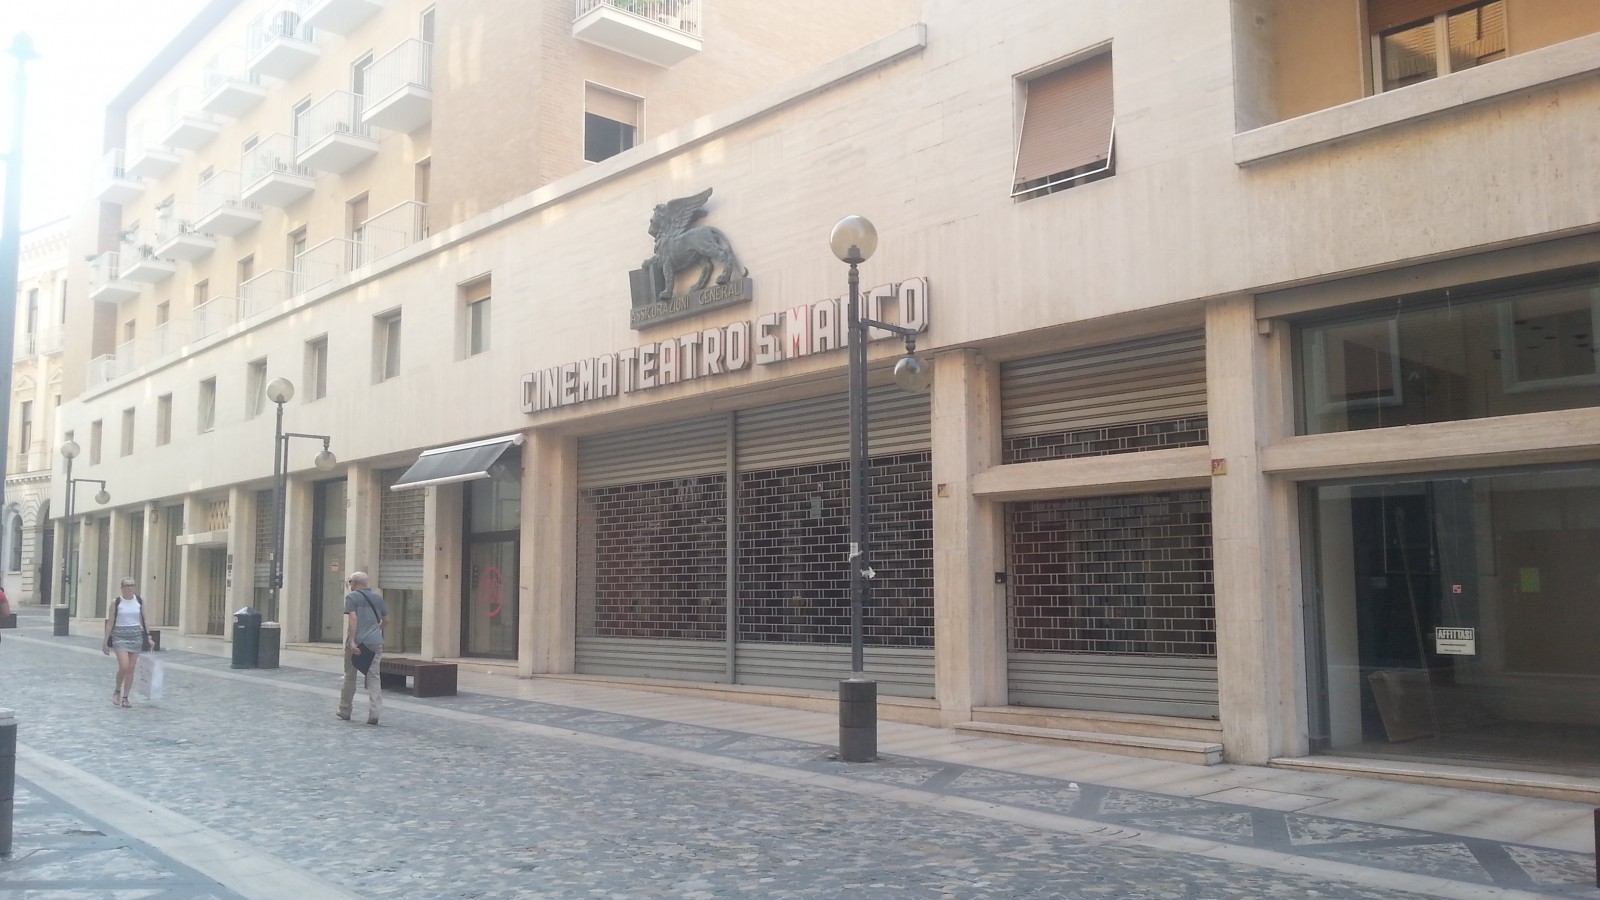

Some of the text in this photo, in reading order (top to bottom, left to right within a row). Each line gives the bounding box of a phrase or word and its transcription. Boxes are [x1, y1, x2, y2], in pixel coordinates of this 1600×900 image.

[630, 280, 744, 324] ASSICURAZIONI GENERALI
[520, 352, 618, 414] CINEMA
[619, 320, 750, 394] TEATRO
[1437, 629, 1474, 640] AFFITTASI
